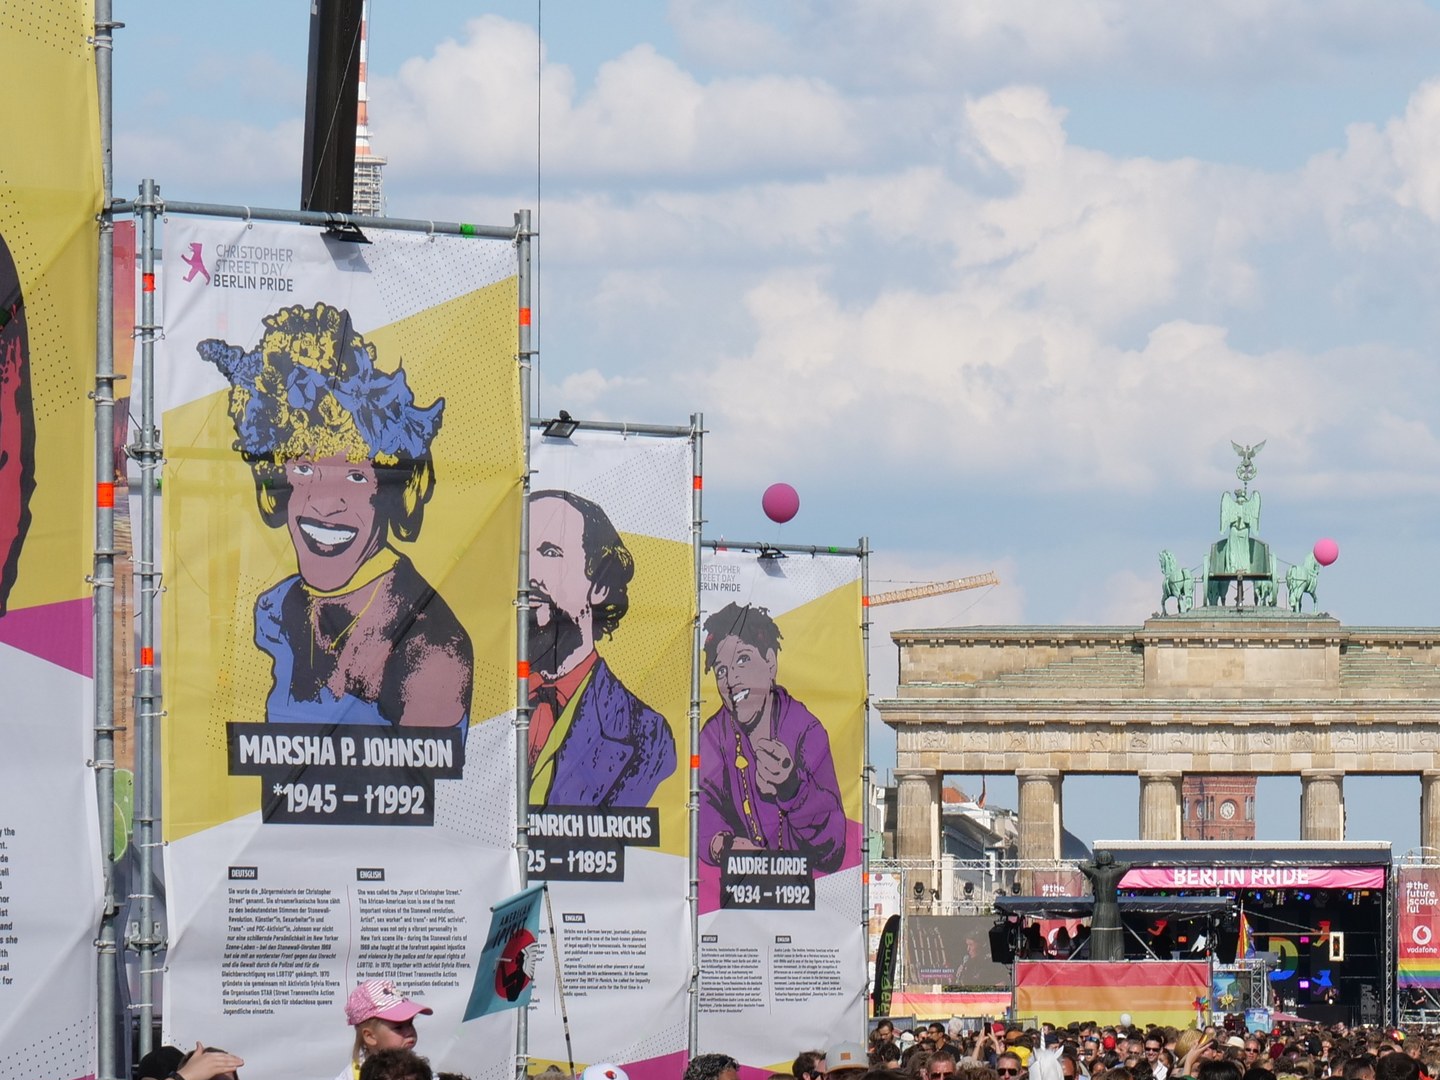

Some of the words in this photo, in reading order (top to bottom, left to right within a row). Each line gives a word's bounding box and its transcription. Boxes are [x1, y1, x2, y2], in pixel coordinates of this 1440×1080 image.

[216, 244, 293, 262] CHRISTOPHER
[215, 259, 259, 274] STREET
[262, 262, 284, 276] DAY
[213, 274, 256, 289] BERLIN
[260, 277, 293, 292] PRIDE
[722, 574, 735, 582] DAY
[720, 583, 741, 592] PRIDE
[239, 735, 336, 765] MARSHA
[341, 737, 356, 765] P.
[362, 738, 452, 767] JOHNSON
[587, 815, 651, 838] ULRICHS
[4, 827, 15, 836] the
[728, 857, 768, 875] AUDRE
[771, 857, 807, 875] LORDE
[231, 869, 255, 878] DEUTSCH
[1174, 867, 1244, 885] BERLIN
[1251, 867, 1309, 885] PRIDE
[1042, 884, 1064, 893] #the
[1406, 881, 1429, 889] #the
[1406, 889, 1436, 897] future
[6, 936, 18, 944] she
[3, 976, 13, 985] for
